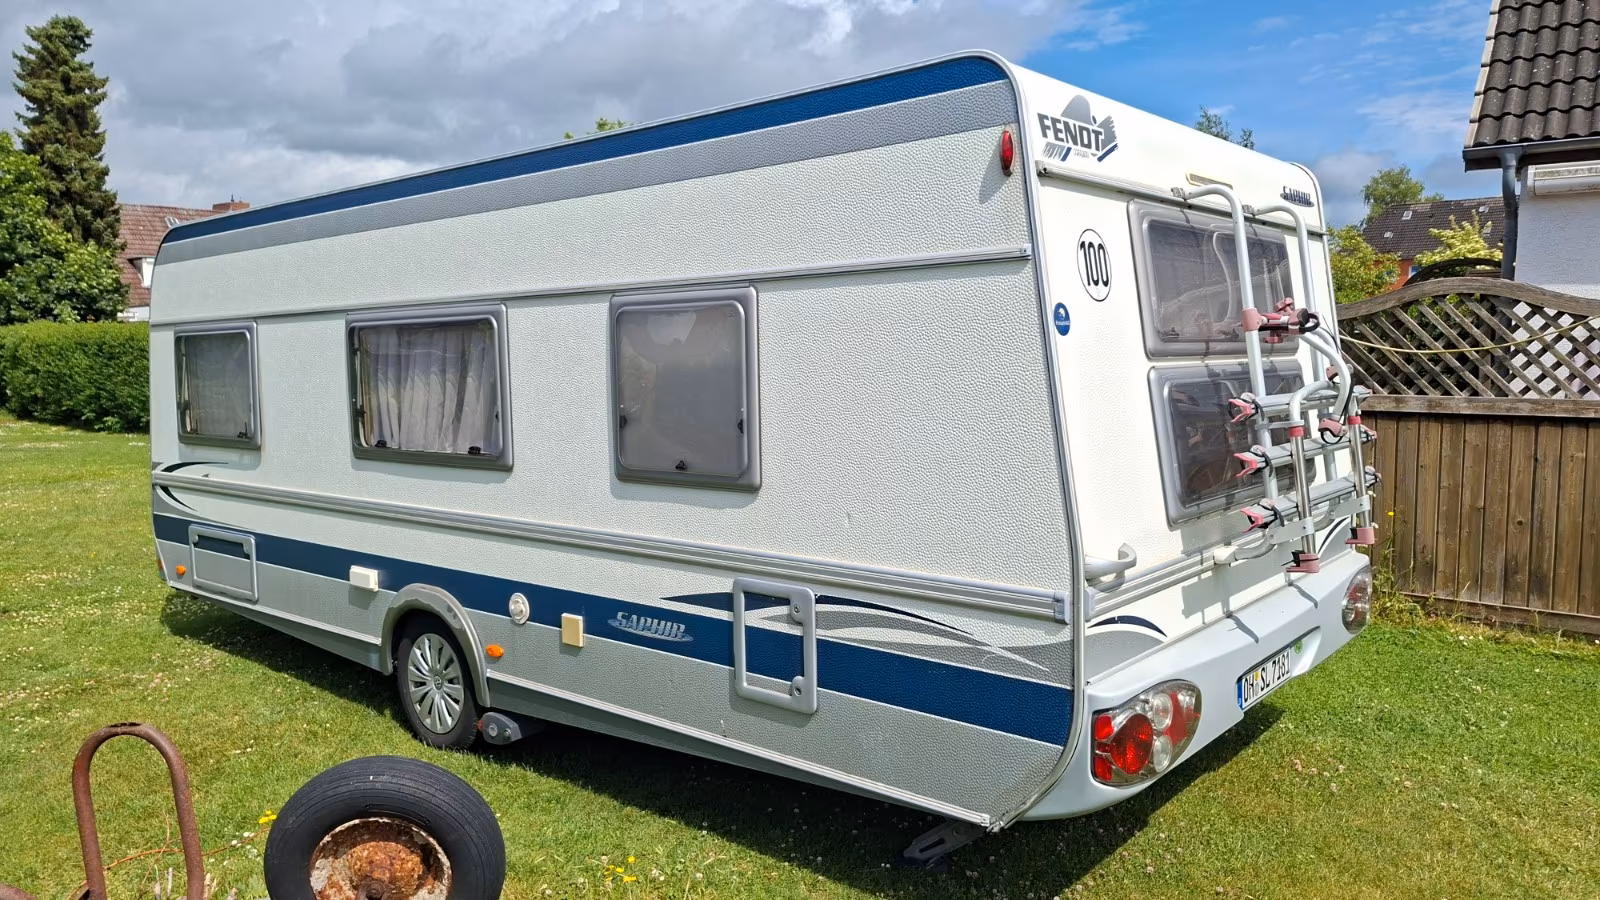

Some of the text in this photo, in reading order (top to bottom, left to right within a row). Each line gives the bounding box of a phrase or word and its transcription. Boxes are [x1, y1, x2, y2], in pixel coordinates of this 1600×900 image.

[1037, 112, 1103, 152] FENDT
[1080, 240, 1109, 287] 100
[616, 611, 686, 640] SAPHIR
[1243, 673, 1255, 703] OH
[1260, 664, 1271, 692] SL
